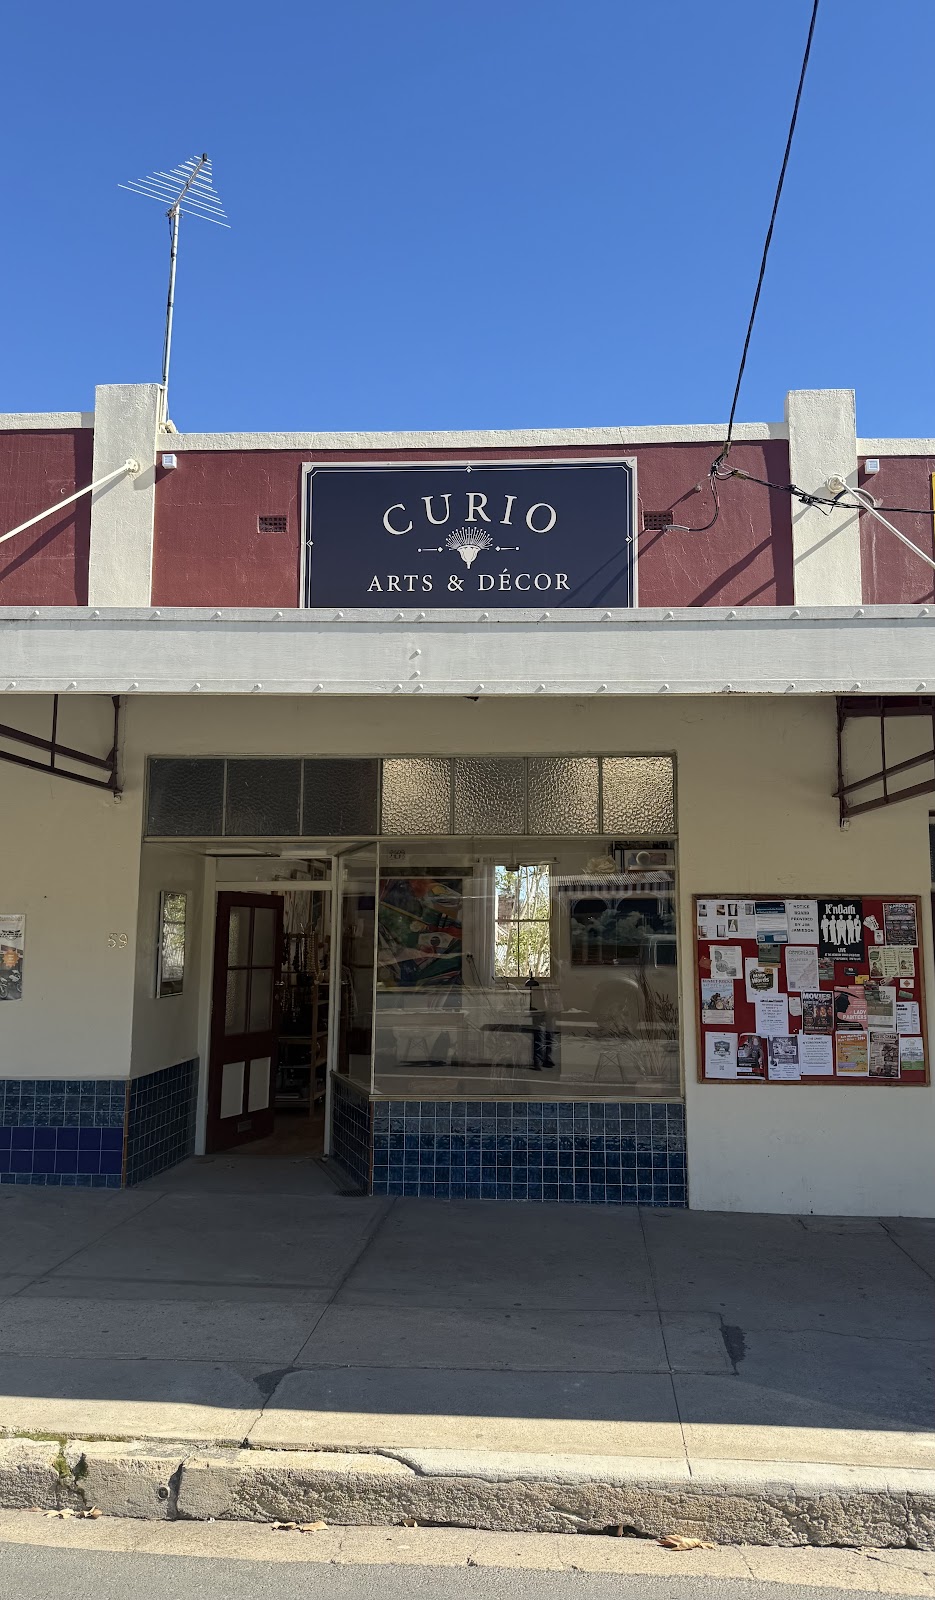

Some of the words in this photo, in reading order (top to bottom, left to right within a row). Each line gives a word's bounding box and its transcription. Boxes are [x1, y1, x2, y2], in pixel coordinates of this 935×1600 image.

[382, 491, 558, 536] CURIO
[367, 574, 433, 592] ARTS
[447, 574, 464, 592] &
[478, 568, 571, 591] DÉCOR
[107, 932, 128, 949] 59
[802, 992, 832, 1000] MOVIES
